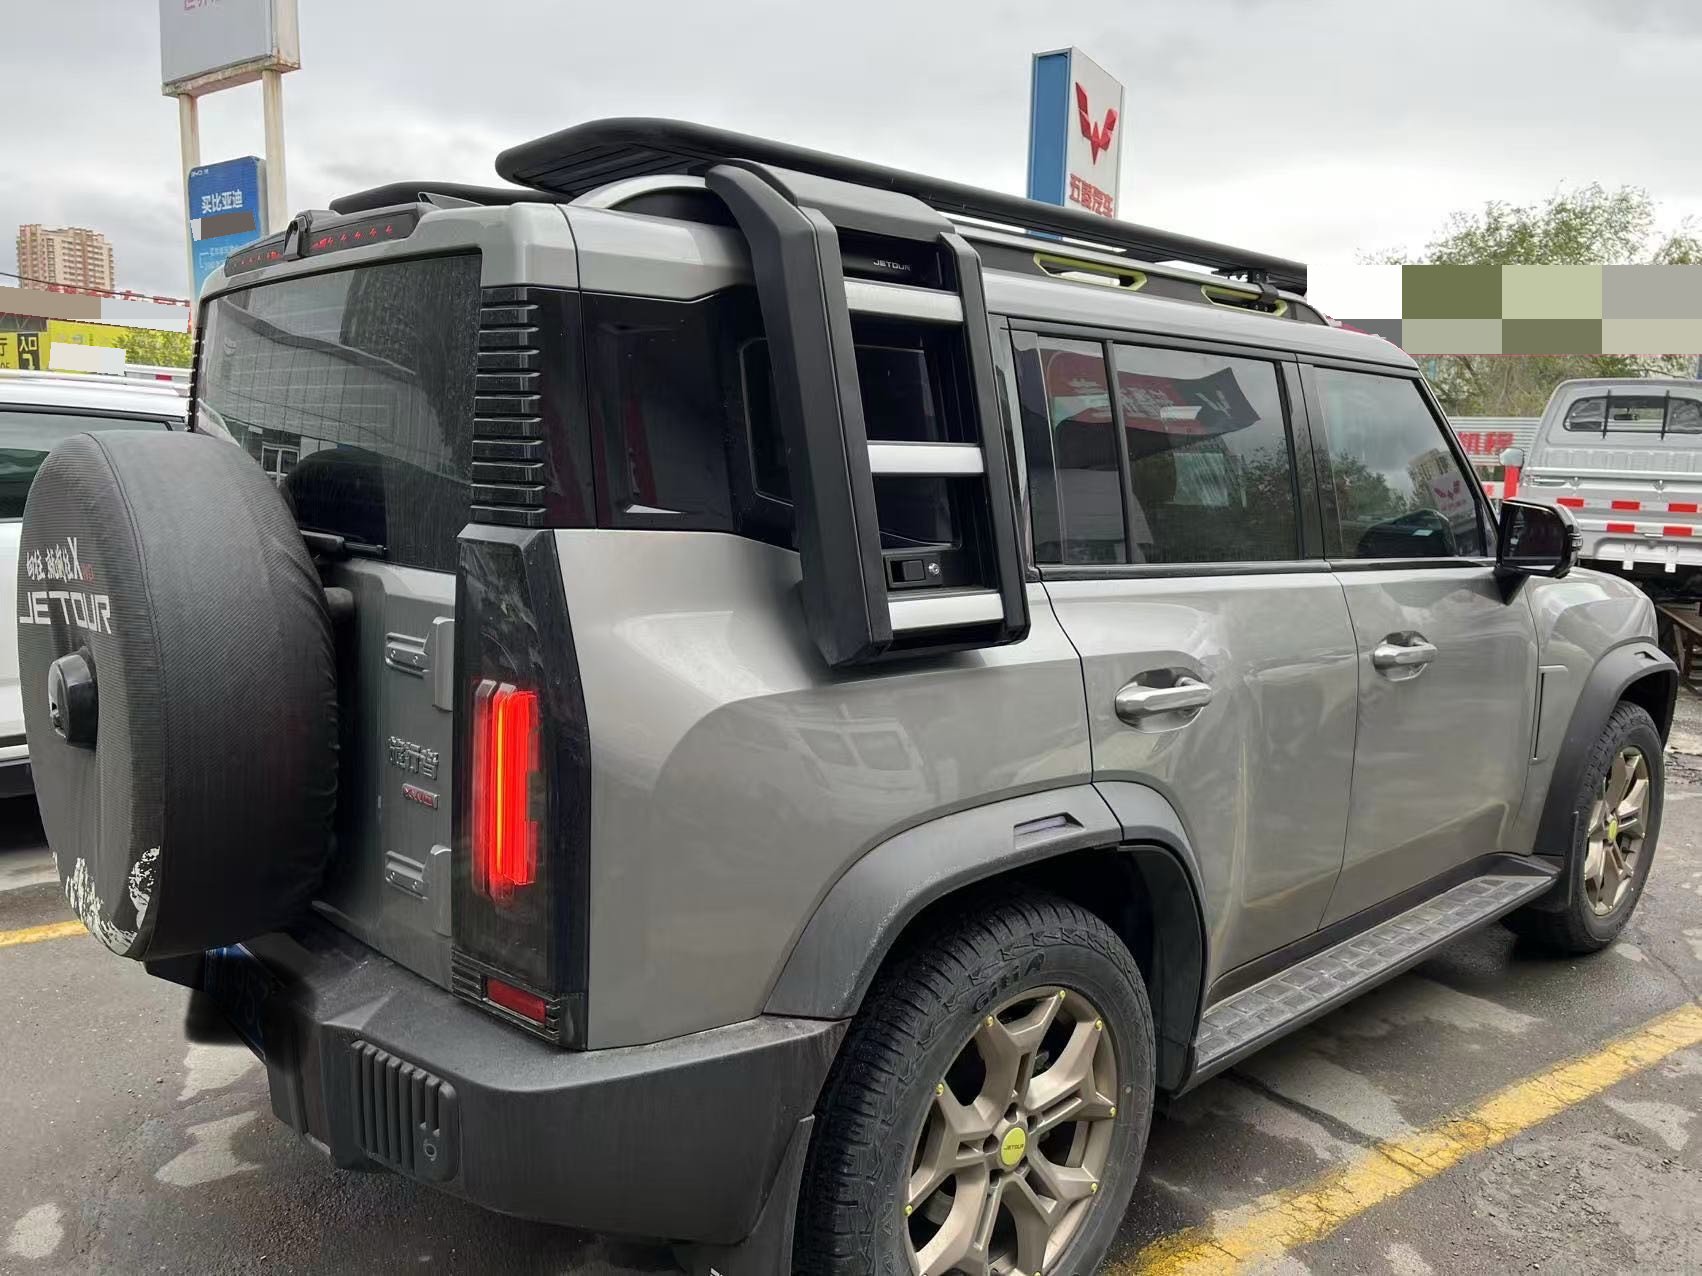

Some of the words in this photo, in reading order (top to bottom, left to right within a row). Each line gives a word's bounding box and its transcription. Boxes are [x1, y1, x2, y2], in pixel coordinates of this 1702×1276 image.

[202, 189, 243, 214] 买比亚迪
[1070, 173, 1114, 219] 五菱汽车
[873, 259, 912, 272] JETOUR
[19, 591, 112, 635] JETOUR
[388, 735, 440, 781] 旅行者
[1003, 1143, 1025, 1151] JETOUR
